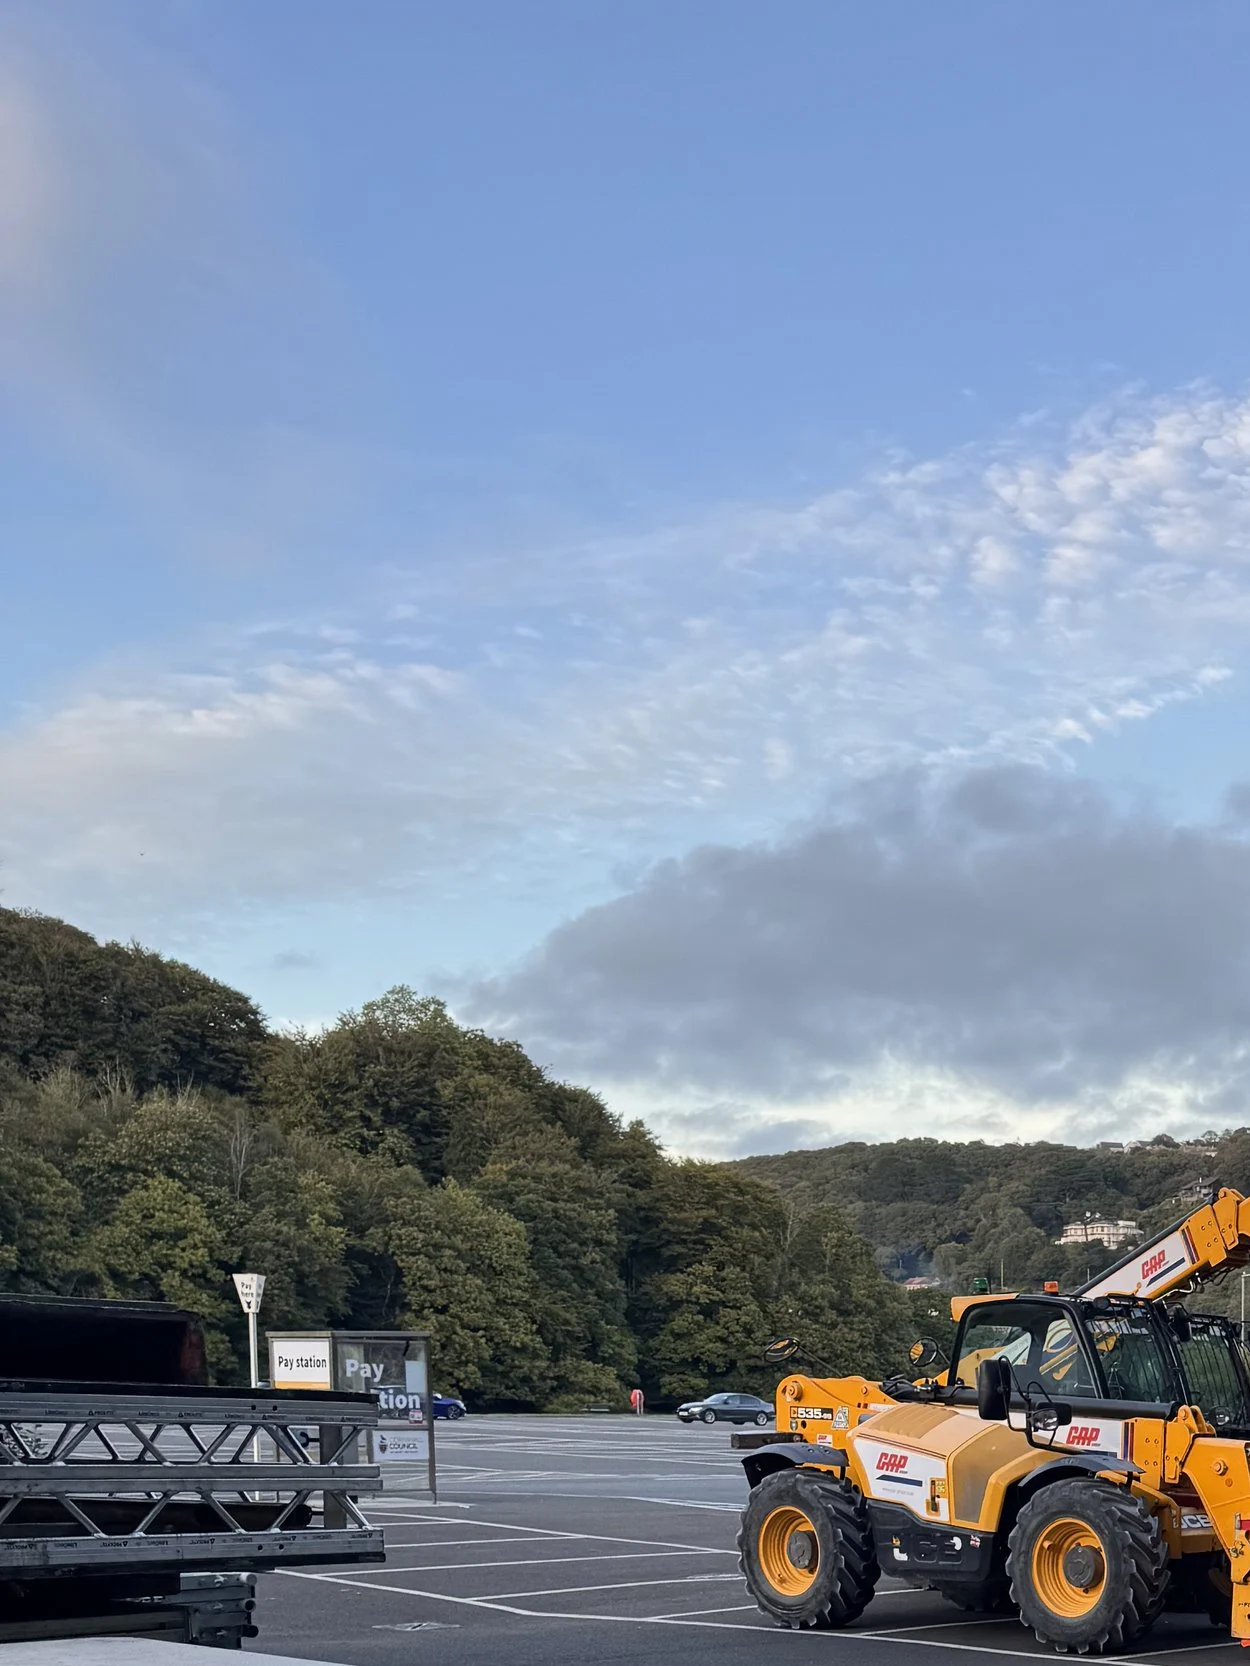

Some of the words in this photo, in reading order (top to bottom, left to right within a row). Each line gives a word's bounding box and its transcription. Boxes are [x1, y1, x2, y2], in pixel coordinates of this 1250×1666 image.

[1141, 1249, 1166, 1280] GAP
[241, 1282, 252, 1290] Pay
[278, 1355, 294, 1371] Pay
[296, 1355, 327, 1369] station
[345, 1359, 384, 1382] Pay
[378, 1388, 421, 1410] tion
[1066, 1426, 1100, 1446] GAP
[876, 1452, 908, 1473] GAP
